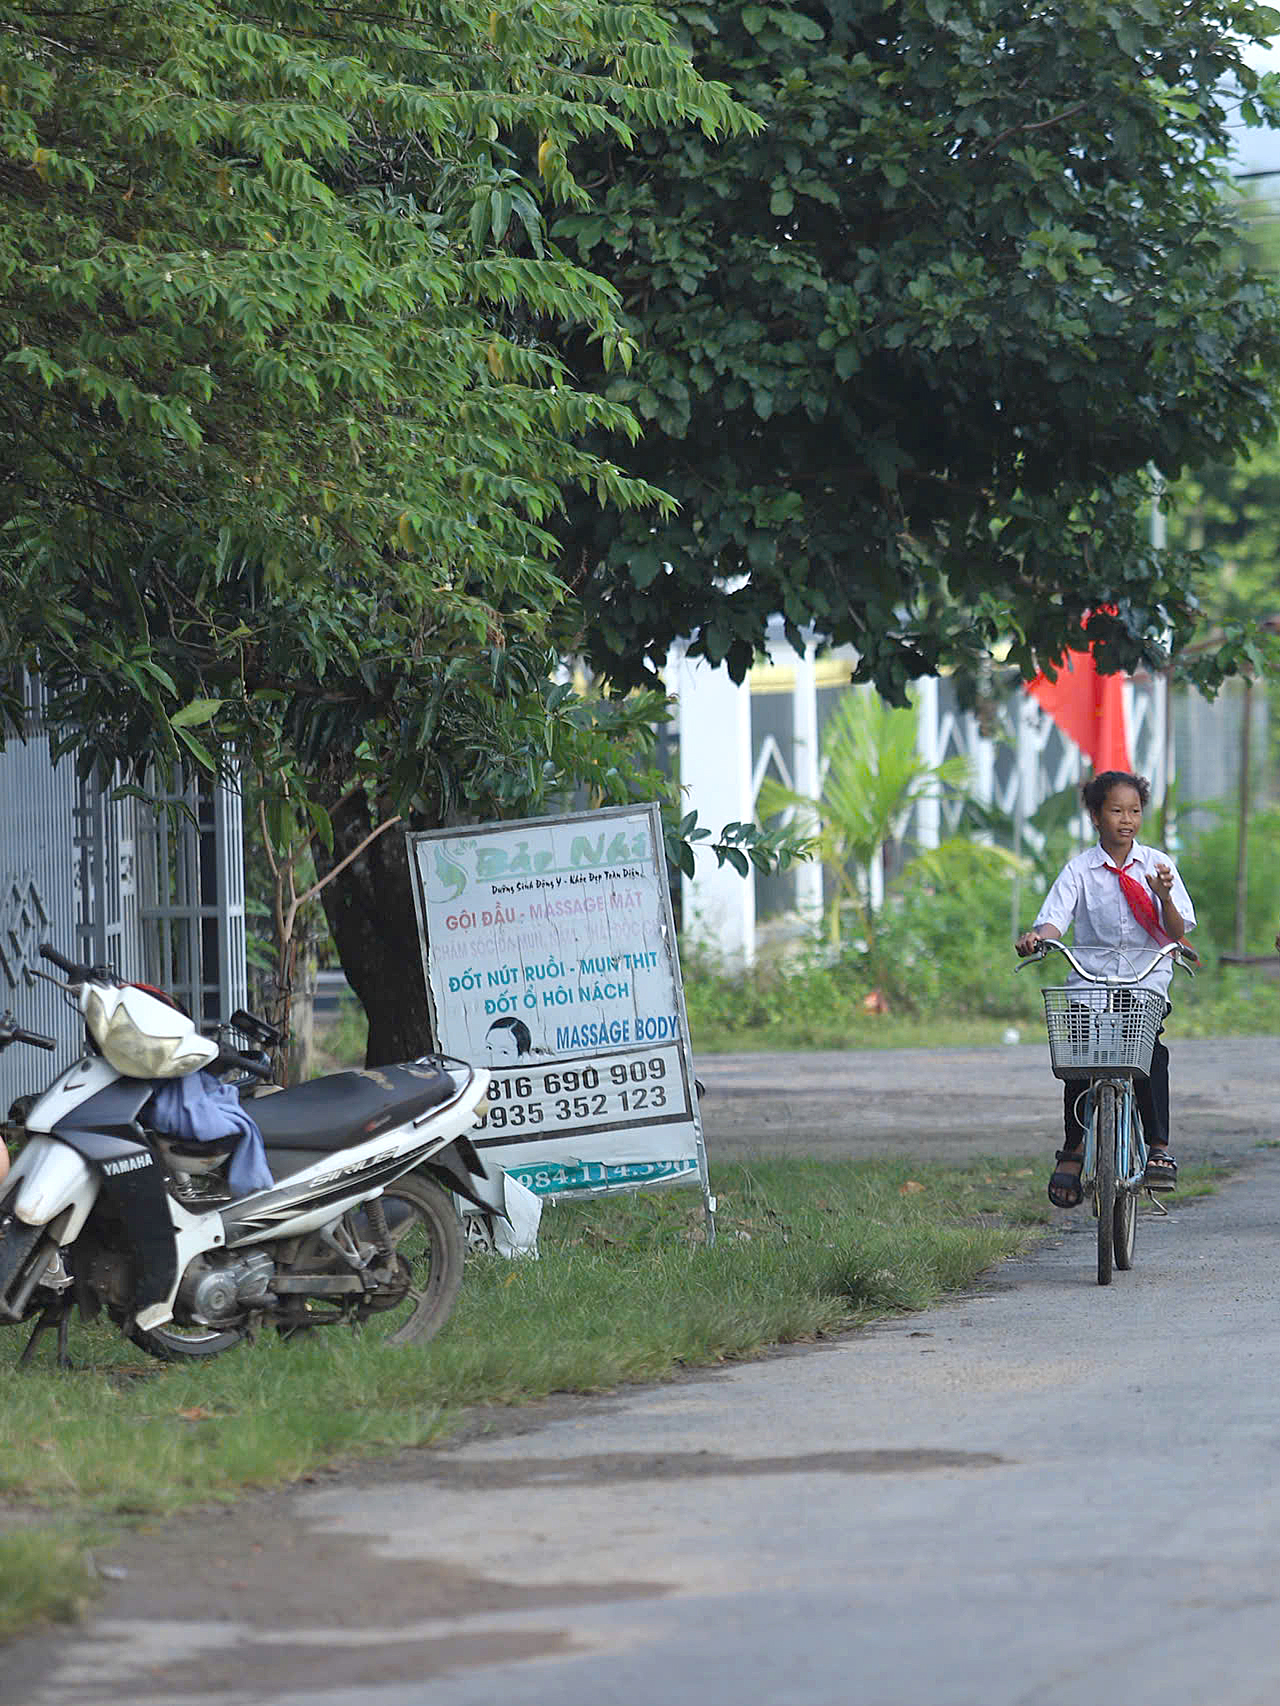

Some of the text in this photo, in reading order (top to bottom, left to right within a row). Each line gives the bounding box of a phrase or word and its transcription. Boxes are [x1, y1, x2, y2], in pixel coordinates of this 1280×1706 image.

[445, 909, 476, 933] GỘI
[481, 901, 516, 927] ĐẦU
[529, 895, 605, 920] MASSAGE
[609, 889, 643, 913] MẶT
[448, 968, 482, 993] ĐỐT
[487, 964, 519, 986] NÚT
[525, 955, 565, 982] RUỒI
[580, 956, 620, 977] MỤN
[623, 951, 657, 973] THỊT
[484, 980, 630, 1014] ĐỐT Ổ HÔI NÁCH
[556, 1015, 679, 1050] MASSAGE BODY
[544, 1066, 600, 1094] 690
[610, 1057, 666, 1085] 909
[555, 1094, 608, 1120] 352
[617, 1085, 667, 1112] 123
[104, 1152, 153, 1176] YAMAHA
[309, 1145, 400, 1188] SIRIUS
